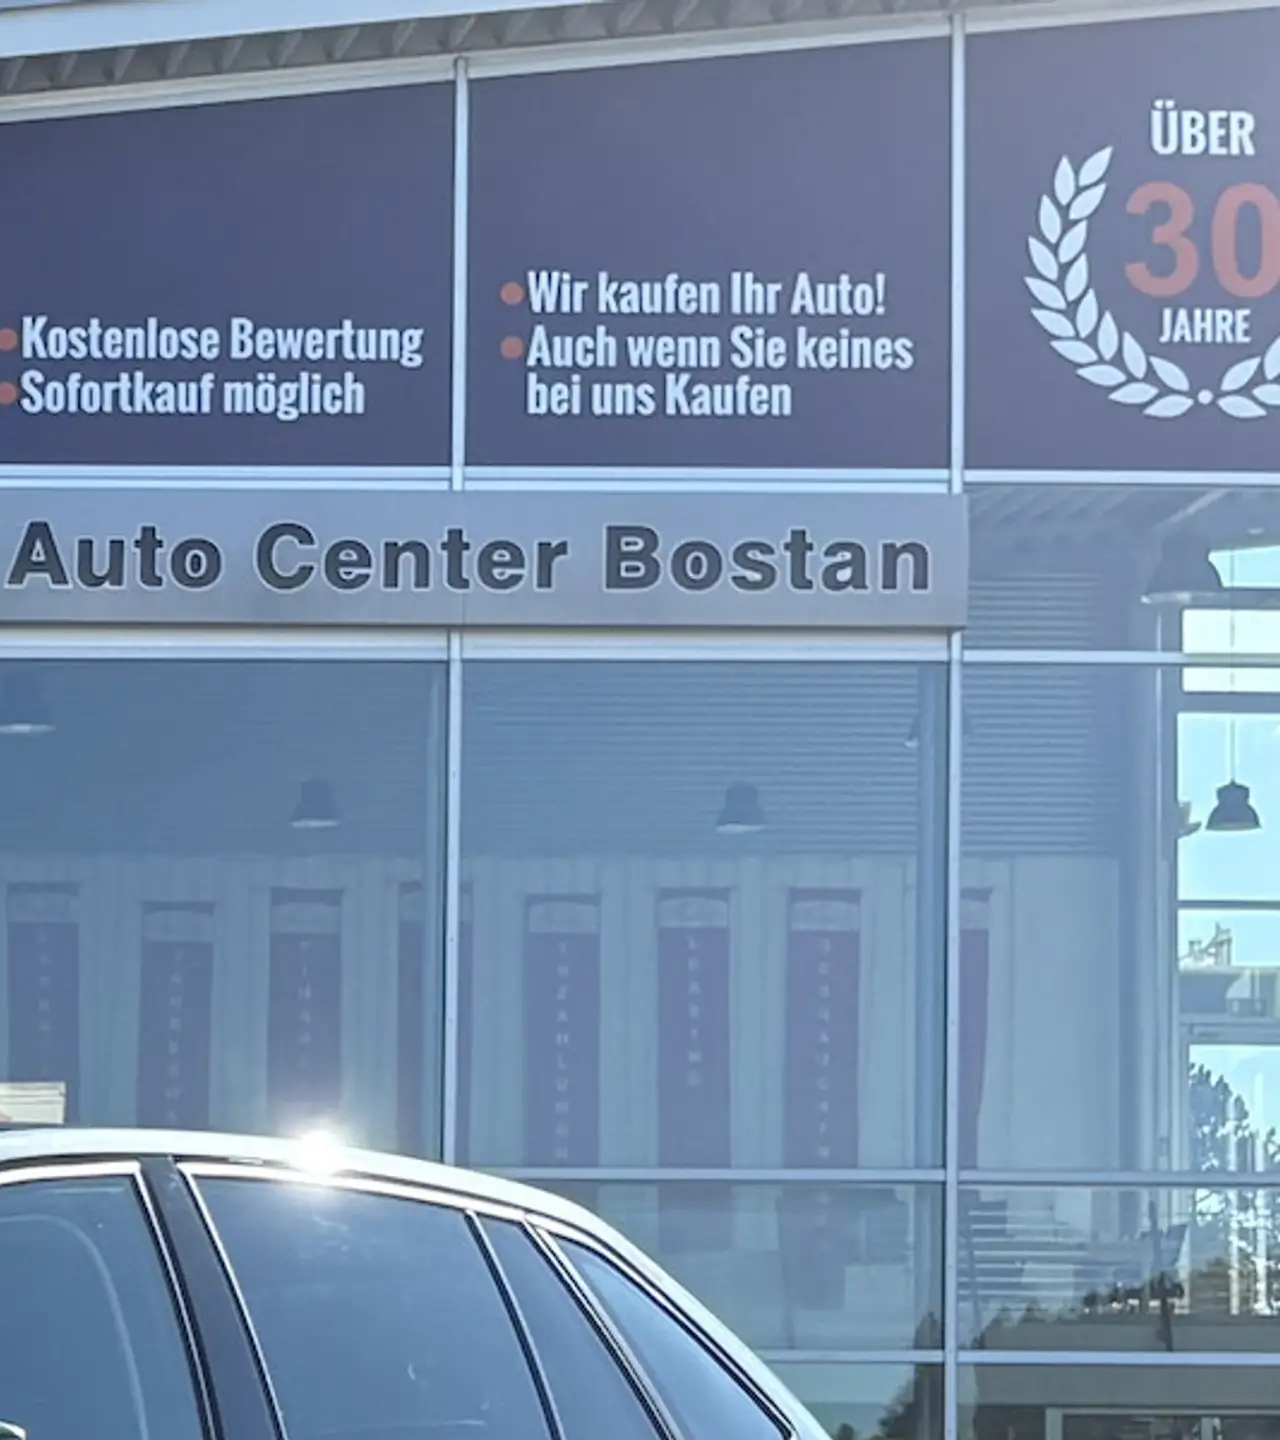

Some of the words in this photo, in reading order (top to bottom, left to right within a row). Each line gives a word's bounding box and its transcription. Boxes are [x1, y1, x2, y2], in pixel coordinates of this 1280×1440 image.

[1151, 99, 1256, 156] ÜBER
[1125, 181, 1280, 299] 30
[527, 270, 590, 314] Wir
[598, 271, 721, 315] kaufen
[731, 272, 782, 315] Ihr
[790, 272, 886, 316] Auto!
[22, 316, 221, 361] Kostenlose
[230, 317, 425, 368] Bewertung
[527, 325, 618, 369] Auch
[626, 335, 721, 370] wenn
[730, 327, 787, 370] Sie
[796, 326, 914, 371] keines
[1158, 307, 1252, 344] JAHRE
[20, 370, 215, 414] Sofortkauf
[223, 370, 365, 421] möglich
[527, 374, 581, 416] bei
[591, 382, 656, 416] uns
[665, 376, 792, 417] Kaufen
[5, 519, 222, 589] Auto
[255, 520, 569, 592] Center
[604, 524, 931, 592] Bostan
